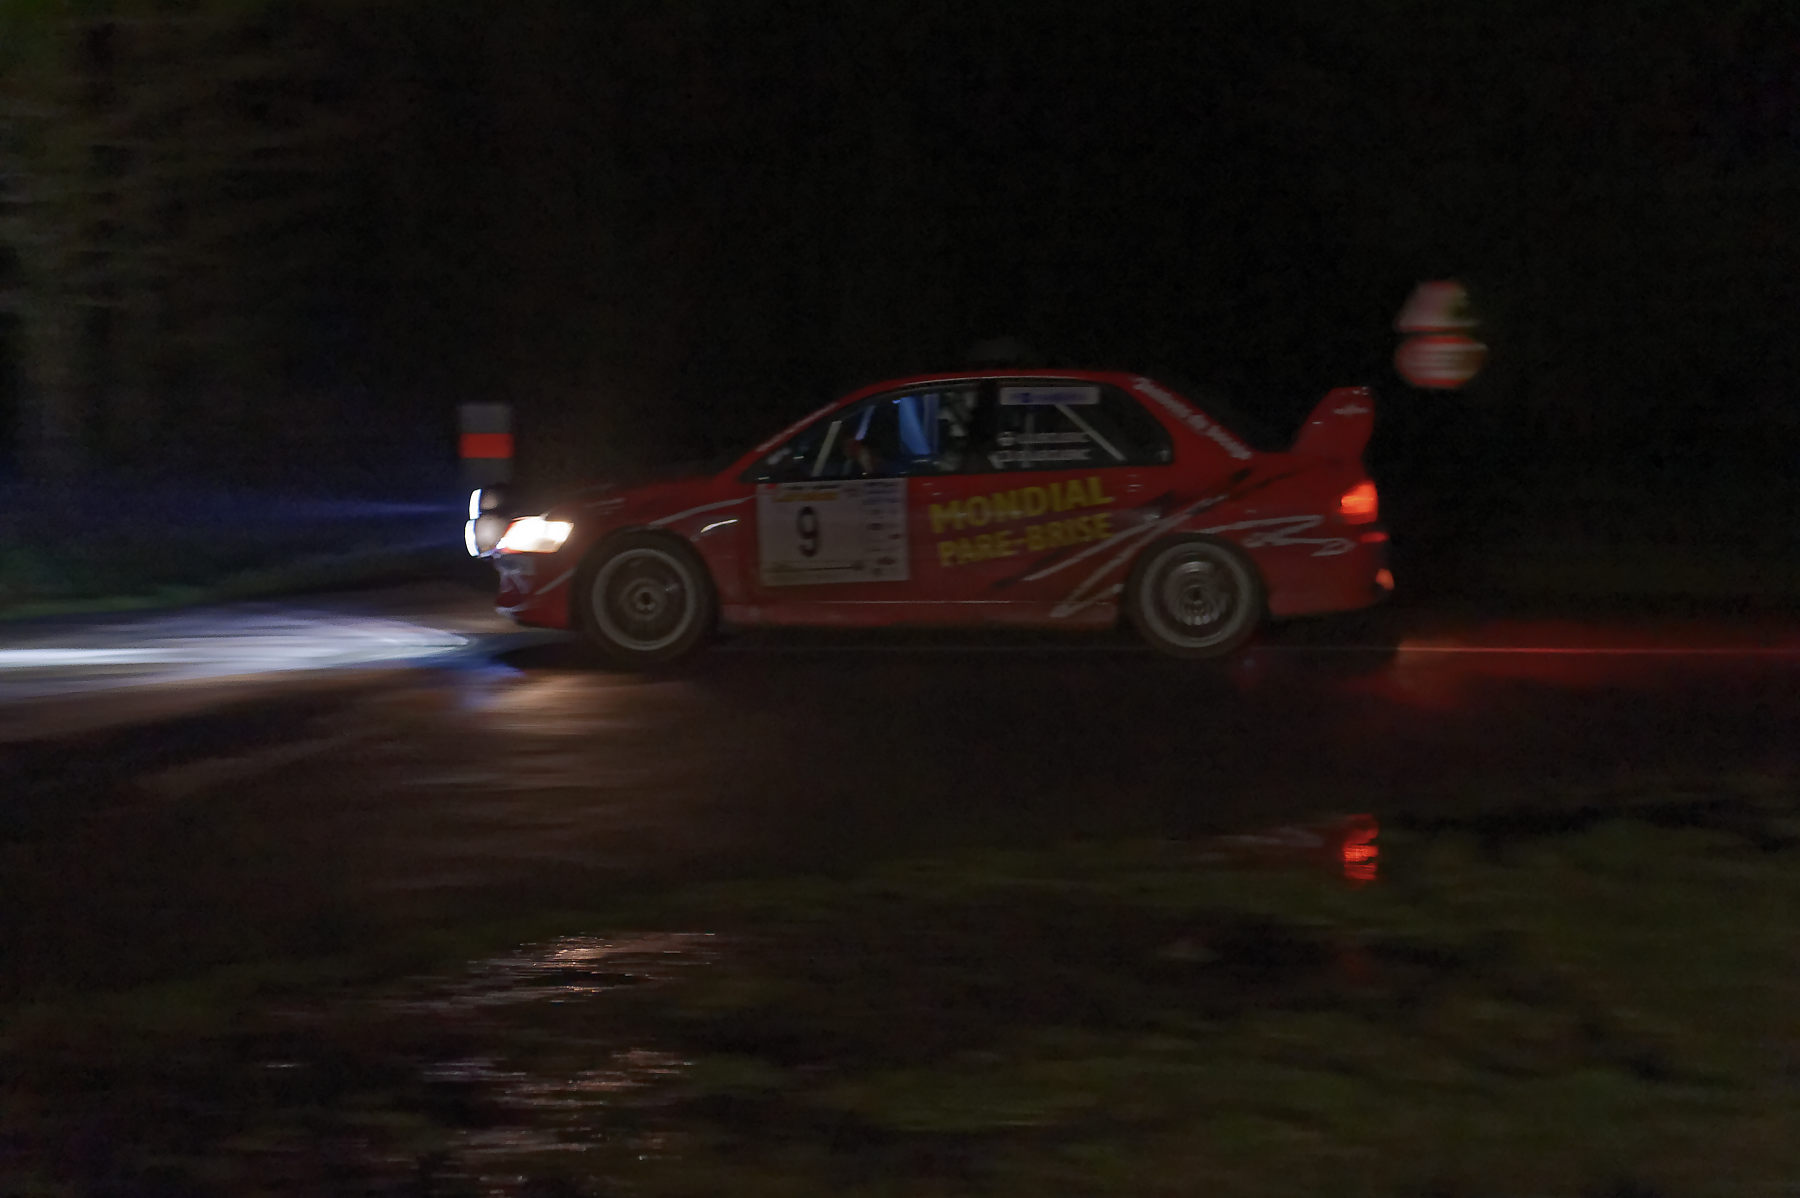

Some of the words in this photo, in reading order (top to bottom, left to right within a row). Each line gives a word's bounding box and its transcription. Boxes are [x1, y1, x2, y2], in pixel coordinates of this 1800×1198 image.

[797, 506, 820, 557] 9
[928, 476, 1115, 534] MONDIAL
[937, 512, 1113, 567] PARE-BRISE
